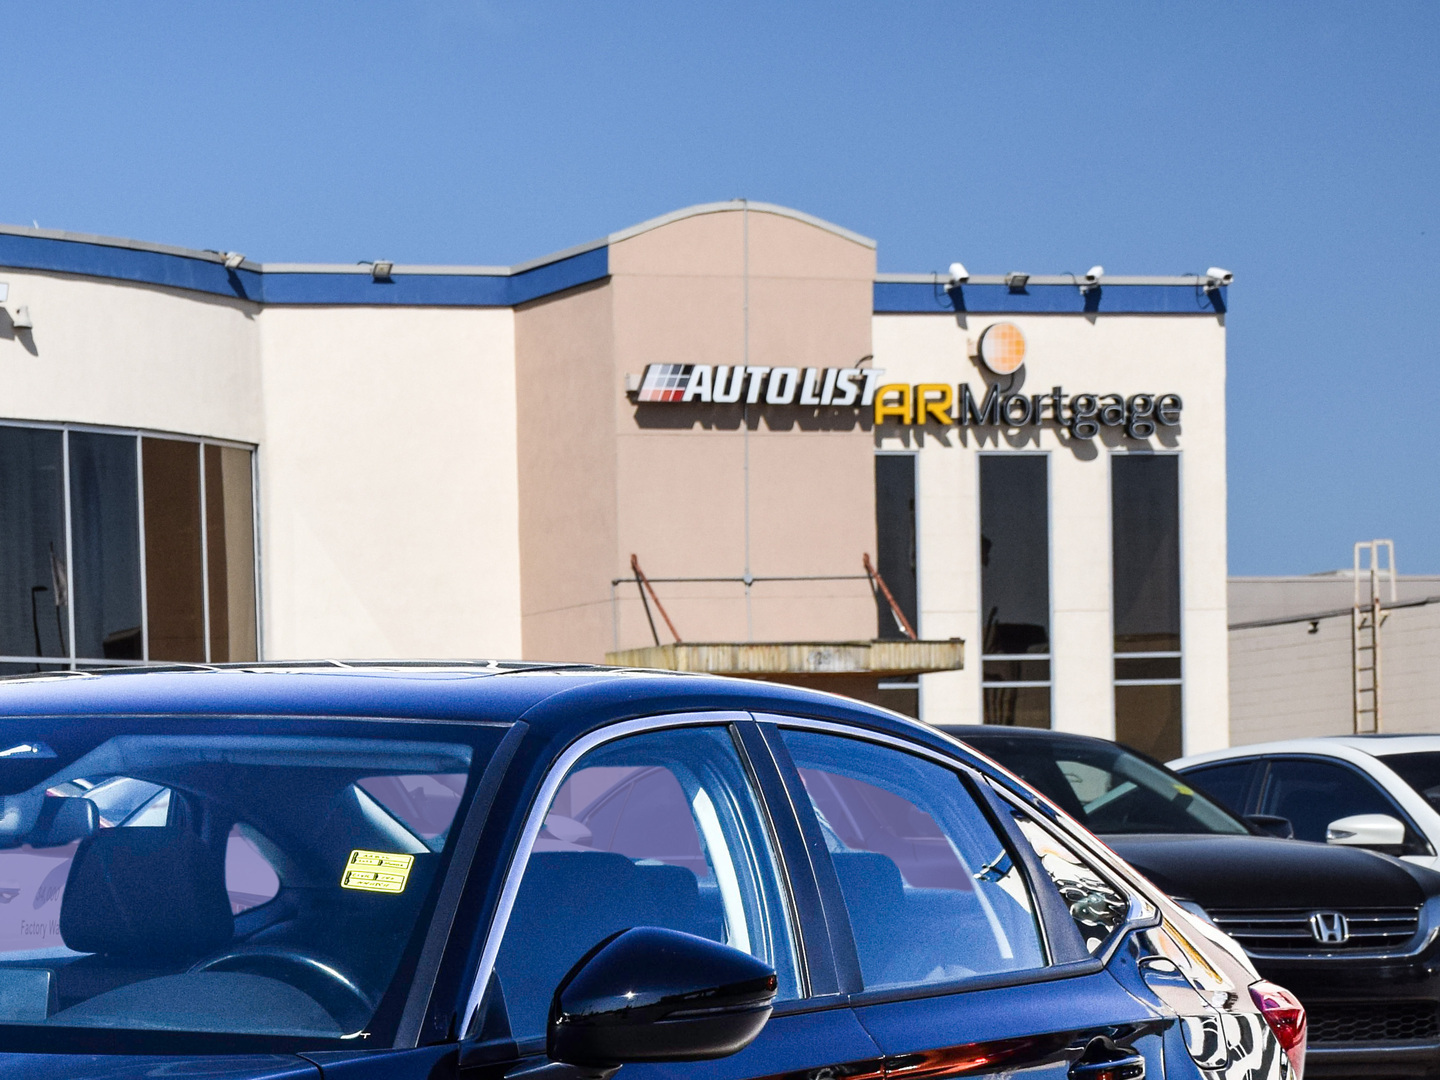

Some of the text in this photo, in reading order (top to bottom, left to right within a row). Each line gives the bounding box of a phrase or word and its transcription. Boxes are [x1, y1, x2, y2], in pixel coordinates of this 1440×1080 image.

[682, 365, 885, 407] AUTO LIST
[874, 382, 1183, 440] AR Mortgage
